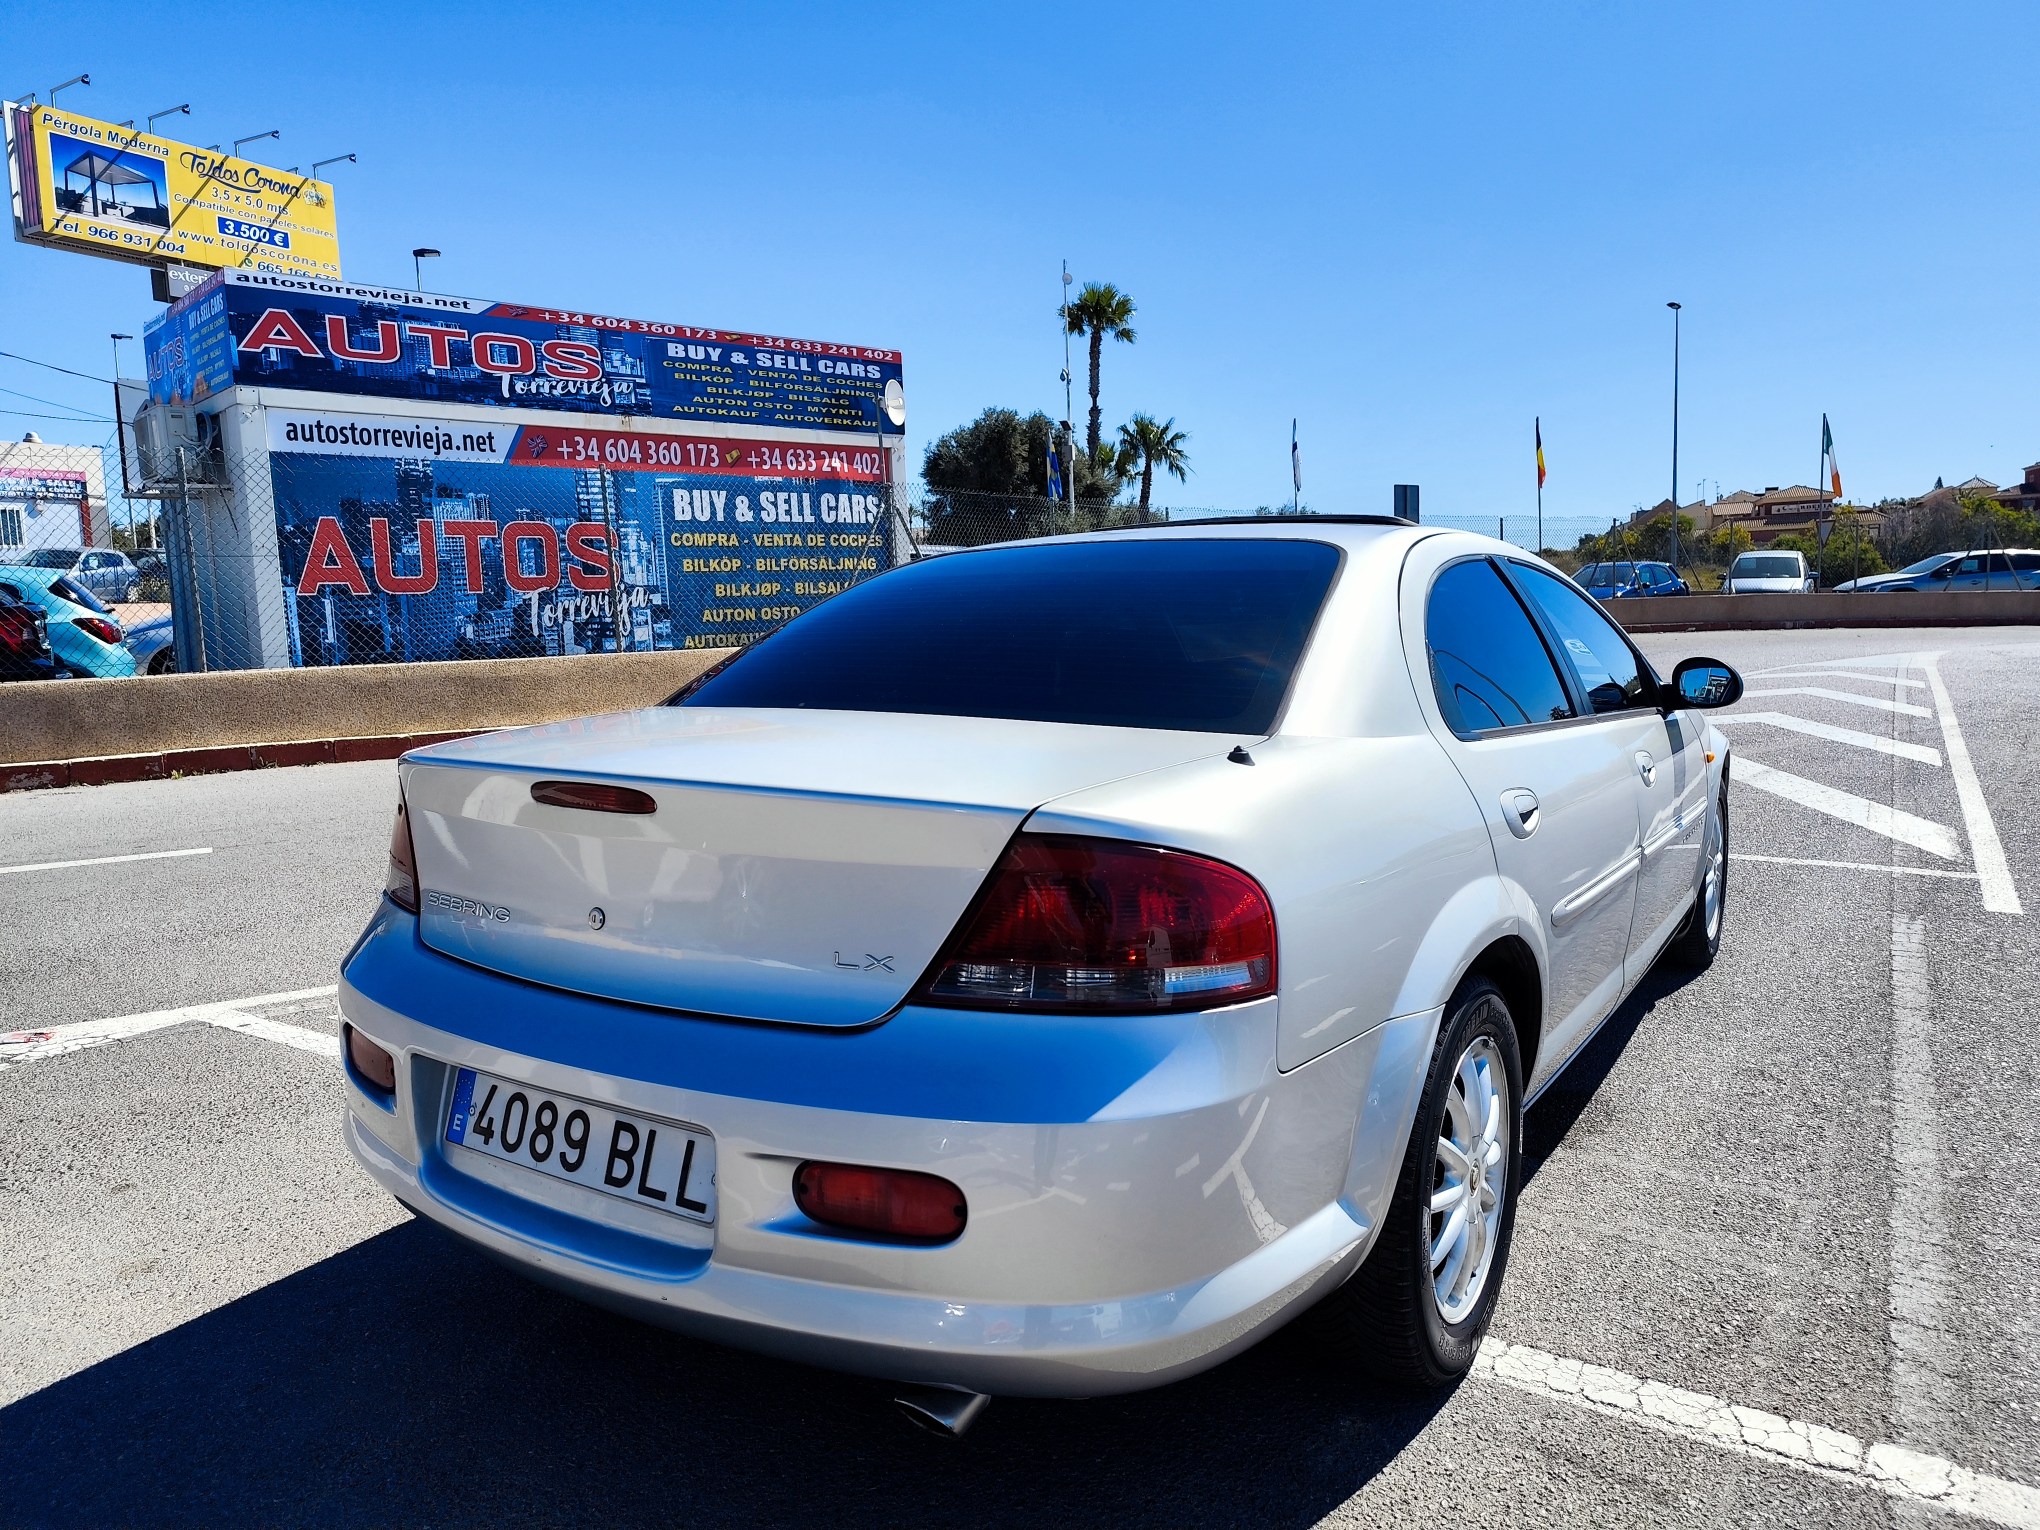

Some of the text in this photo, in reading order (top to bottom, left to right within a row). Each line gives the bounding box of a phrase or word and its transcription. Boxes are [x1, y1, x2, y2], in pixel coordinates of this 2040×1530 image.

[43, 113, 169, 156] Pérgola Moderna
[180, 151, 301, 199] Toldos Corona
[174, 193, 335, 239] Compatible con paneles solares
[245, 196, 263, 209] 5,0
[52, 217, 185, 254] Tel. 966 931 004
[177, 230, 338, 272] www.toldoscorona.es
[224, 221, 285, 247] 3.500 €
[235, 272, 470, 311] autostorrevieja.net
[237, 307, 603, 381] AUTOS
[538, 311, 893, 361] +34 604 360 173 +34 633 241 402
[662, 360, 733, 374] COMPRA
[747, 369, 798, 381] VENTA
[803, 375, 821, 383] DE
[826, 377, 883, 390] COCHES
[667, 342, 881, 379] BUY & SELL CARS
[493, 372, 634, 407] Torrevieja
[674, 372, 734, 384] BILKÖP
[749, 379, 876, 398] BILFÖRSÄLJNING
[706, 386, 774, 398] BILKJØP
[788, 394, 850, 405] BILSALG
[673, 405, 760, 418] AUTOKAUF
[774, 413, 878, 428] AUTOVERKAUF
[692, 396, 748, 407] AUTON
[752, 401, 793, 411] OSTO
[807, 405, 863, 416] MYYNTI
[286, 420, 496, 455] autostorrevieja.net
[557, 436, 880, 475] +34 604 360 173 +34 633 241 402
[672, 488, 878, 524] BUY & SELL CARS
[297, 516, 621, 596] AUTOS
[670, 532, 739, 547] COMPRA
[753, 533, 802, 547] VENTA
[807, 533, 826, 546] DE
[830, 533, 883, 547] COCHES
[682, 556, 741, 572] BILKÖP
[715, 582, 781, 597] BILKJØP
[702, 607, 756, 622] AUTON
[428, 890, 511, 924] SEBRING
[833, 951, 896, 974] LX
[452, 1114, 463, 1131] E
[472, 1084, 708, 1214] 4089 BLL
